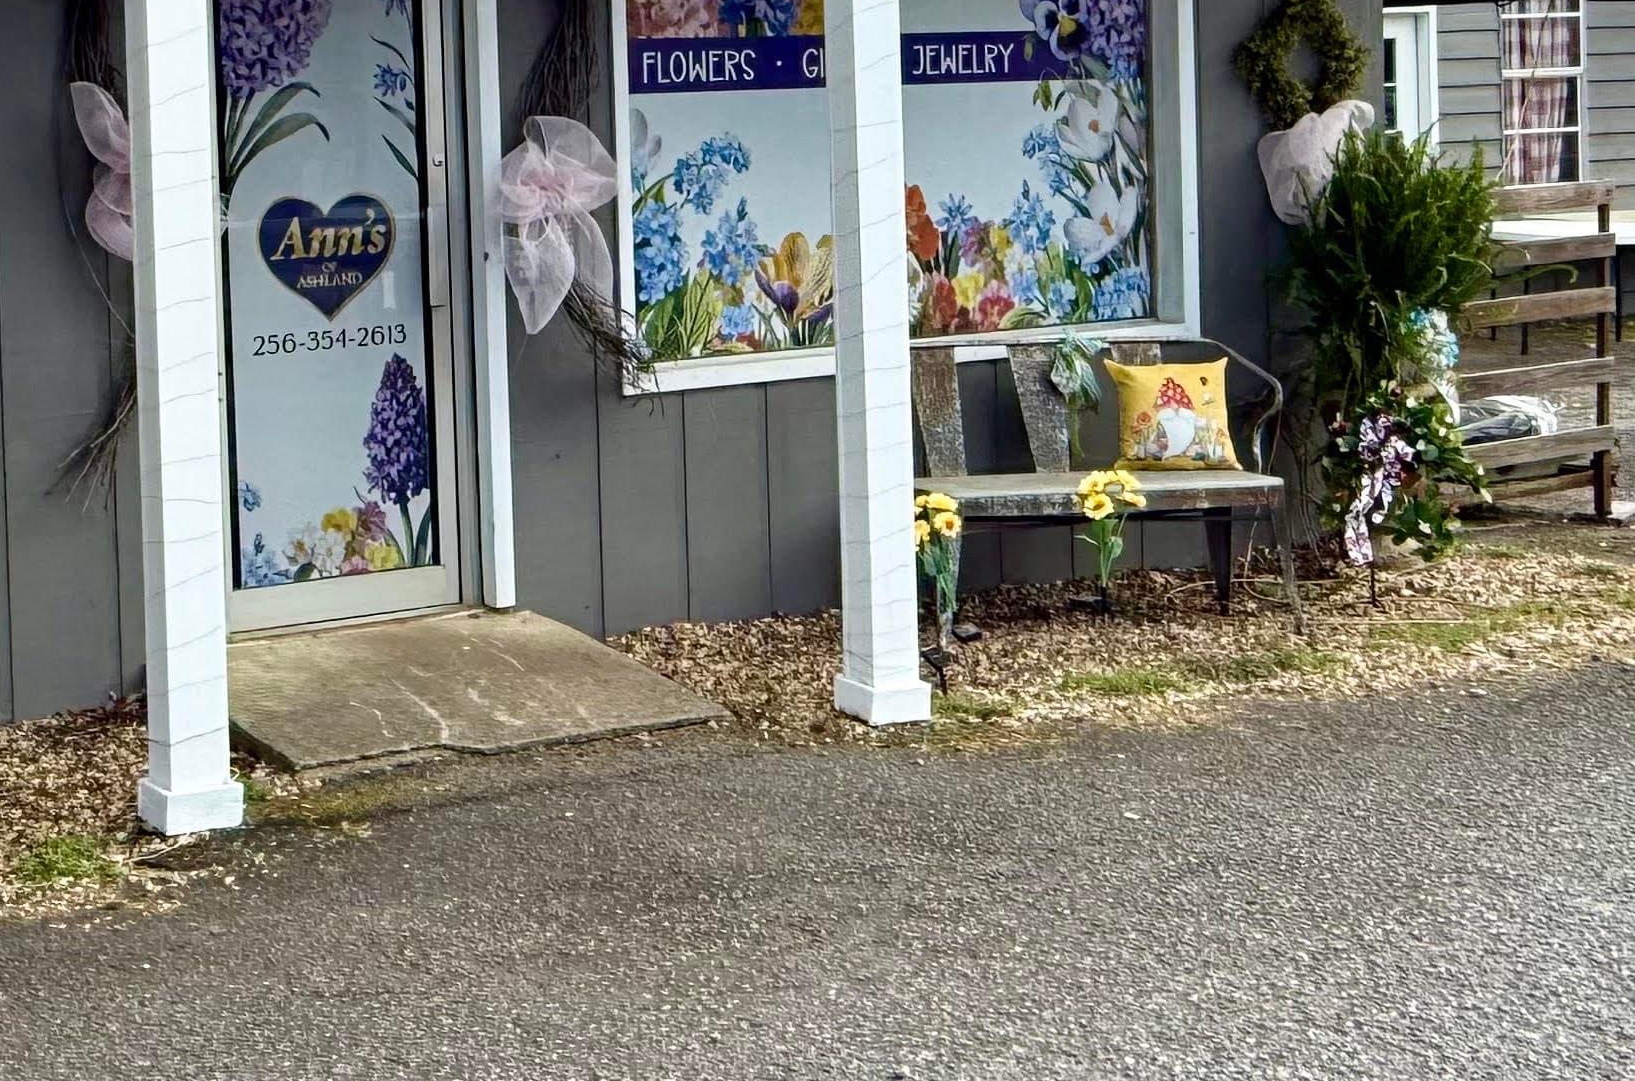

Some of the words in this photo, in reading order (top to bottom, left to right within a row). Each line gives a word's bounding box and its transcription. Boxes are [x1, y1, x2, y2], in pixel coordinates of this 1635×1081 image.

[642, 48, 757, 84] FLOWERS
[911, 42, 1016, 76] JEWELRY
[269, 208, 388, 261] Ann's
[296, 271, 363, 289] ASHLAND
[252, 323, 408, 357] 256-354-2613
